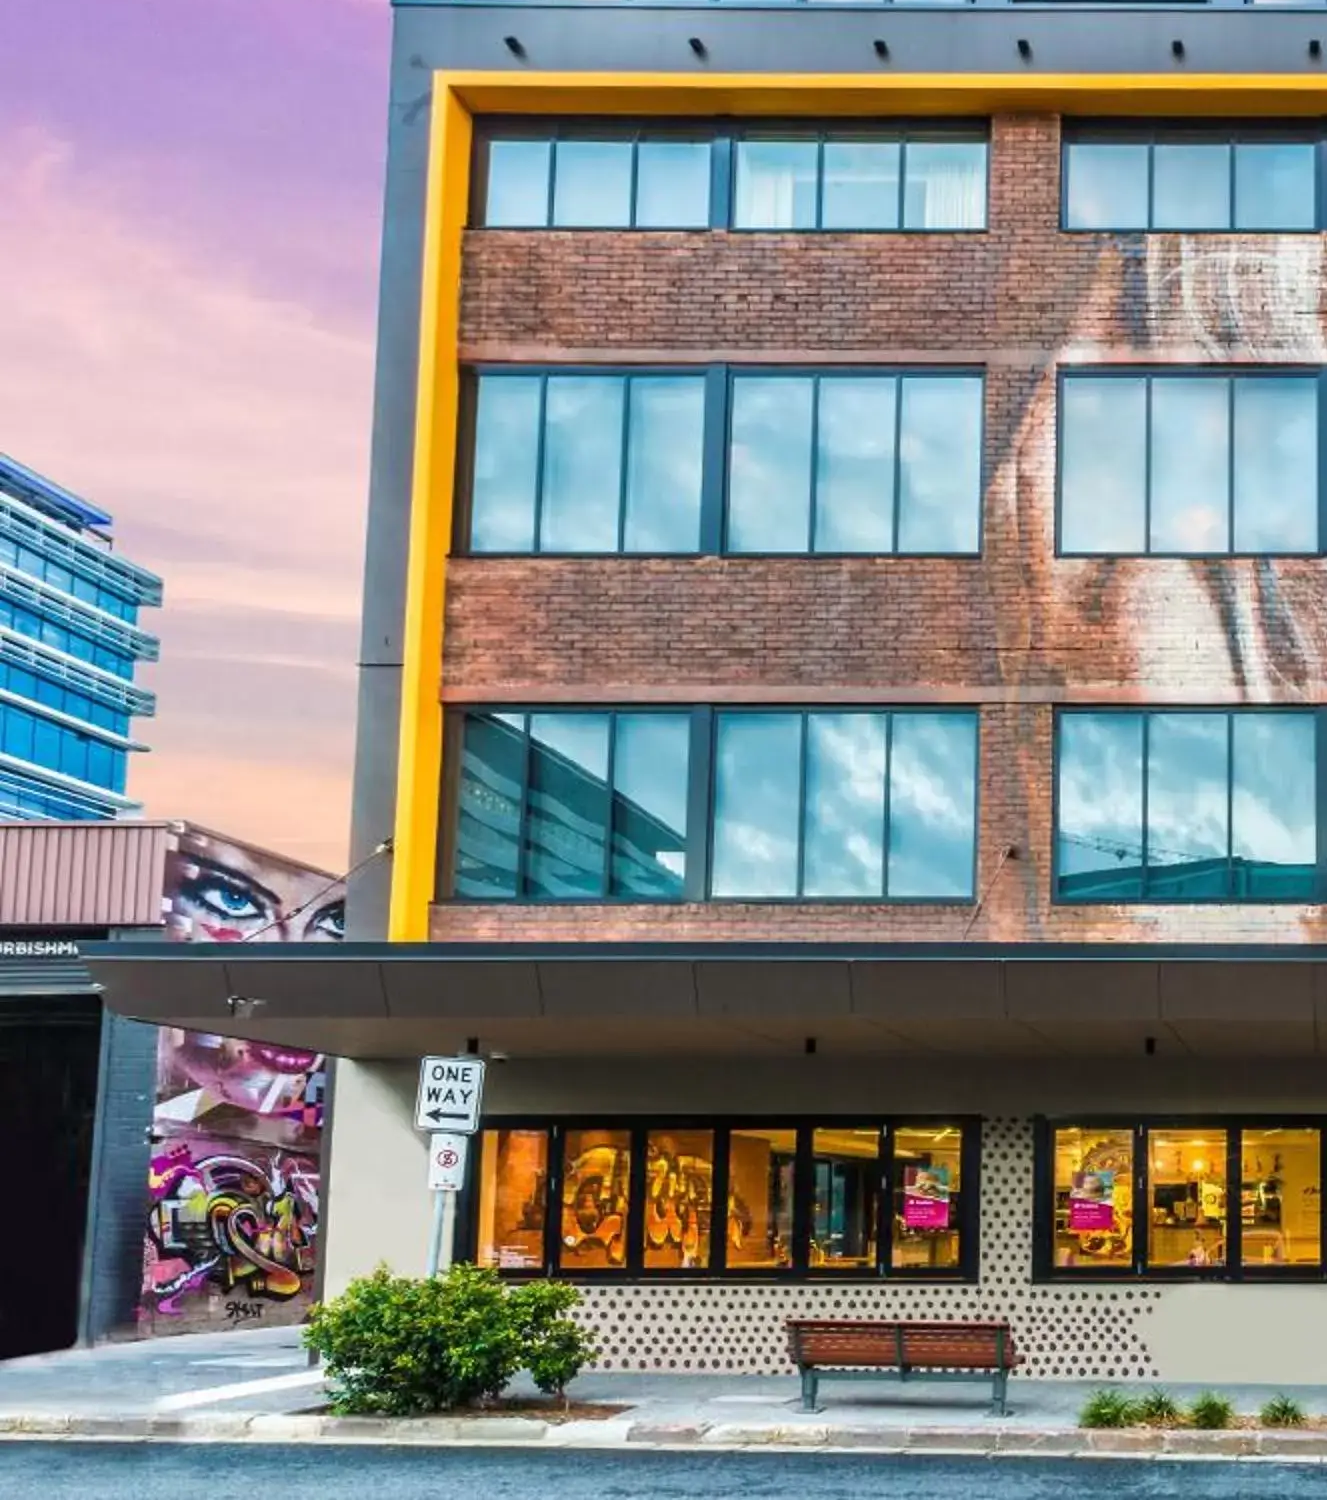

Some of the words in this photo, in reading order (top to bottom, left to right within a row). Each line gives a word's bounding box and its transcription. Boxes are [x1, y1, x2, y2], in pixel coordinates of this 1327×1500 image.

[0, 941, 79, 955] RBISHM
[431, 1066, 473, 1082] ONE
[427, 1087, 473, 1104] WAY
